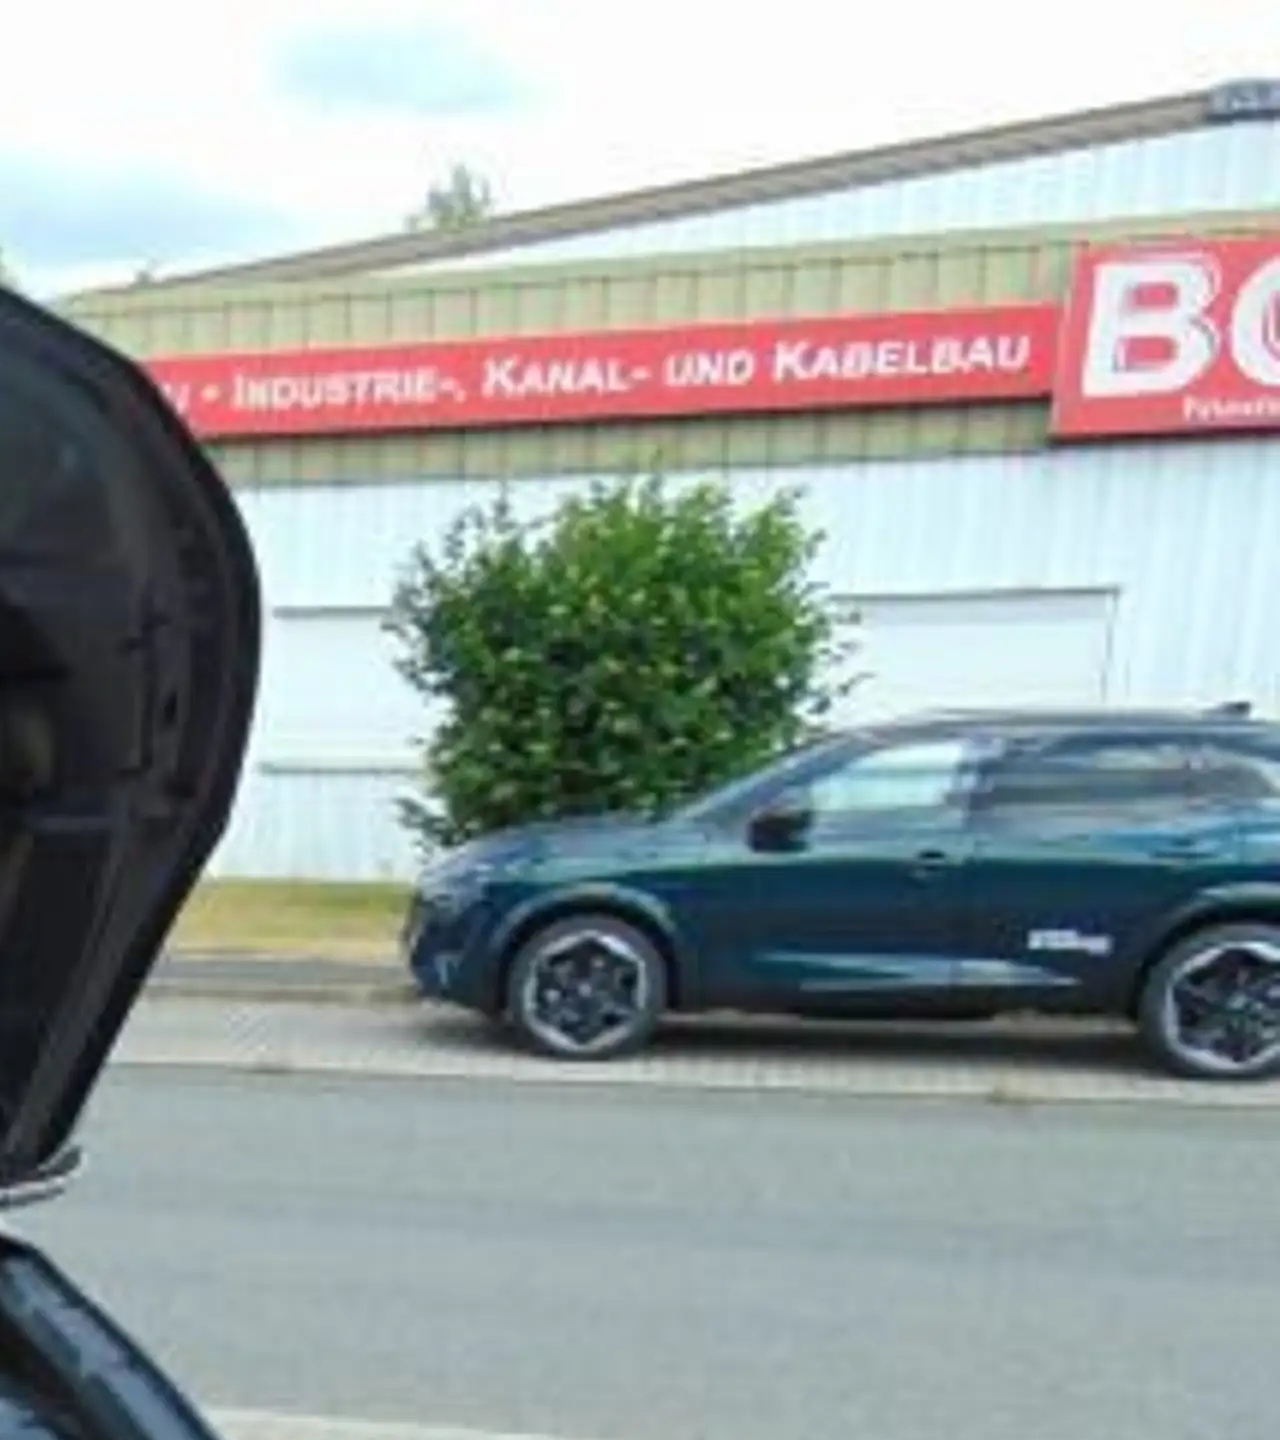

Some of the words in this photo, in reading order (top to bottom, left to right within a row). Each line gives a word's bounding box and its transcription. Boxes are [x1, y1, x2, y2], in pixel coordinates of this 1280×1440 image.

[482, 352, 649, 396] KANAL-
[664, 350, 754, 388] UND
[774, 334, 1032, 381] KABELBAU
